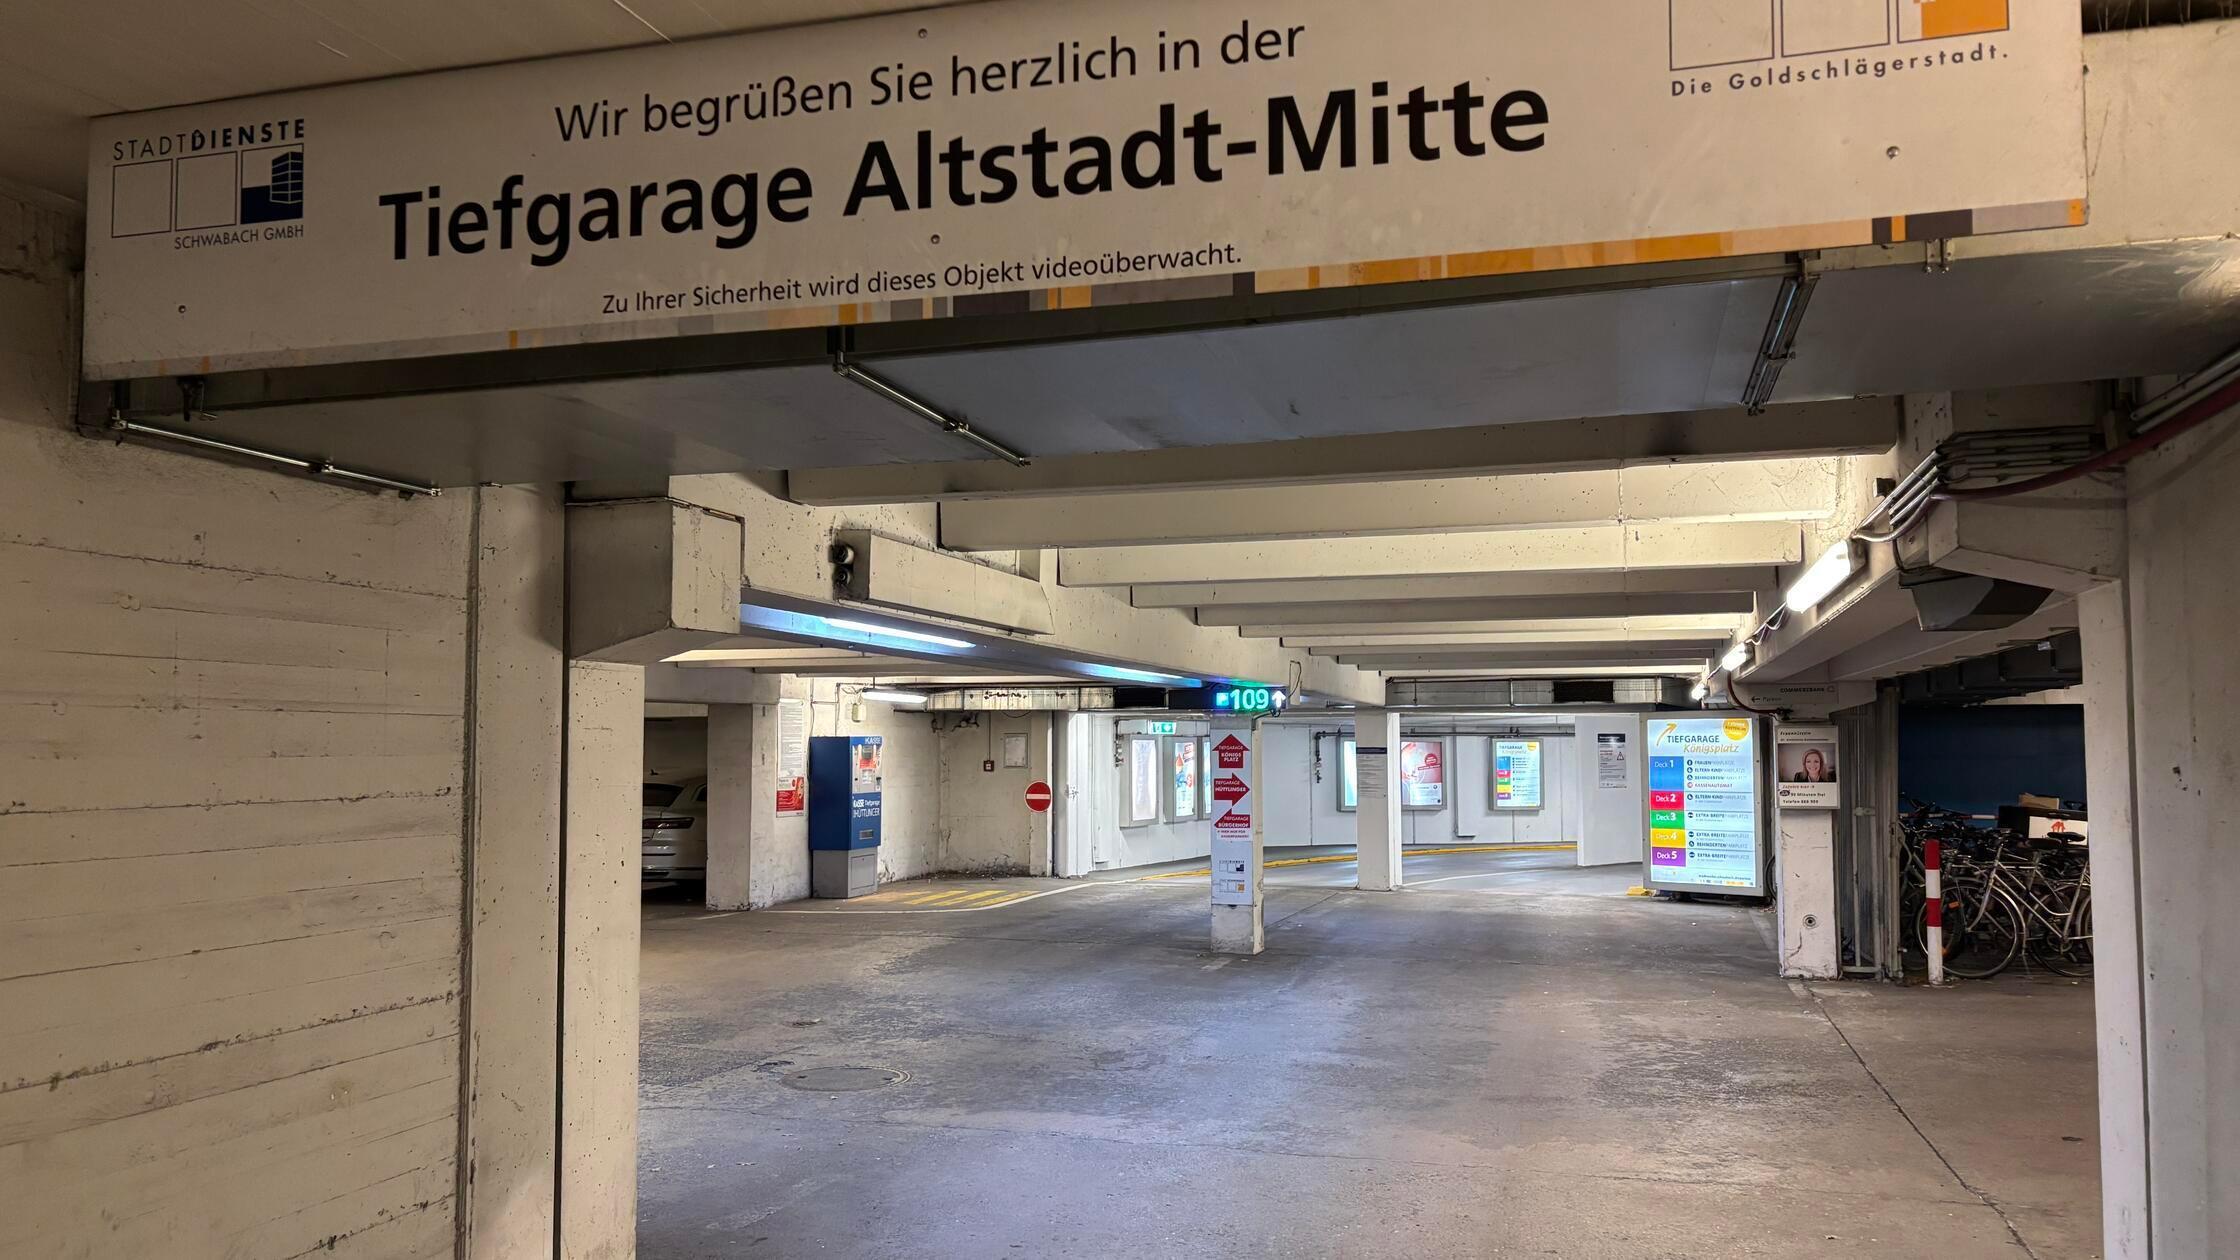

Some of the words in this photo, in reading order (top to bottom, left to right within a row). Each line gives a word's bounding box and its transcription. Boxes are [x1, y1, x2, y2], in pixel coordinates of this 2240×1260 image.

[1671, 77, 1713, 97] Die
[1728, 43, 2009, 91] Goldschlägerstadt.
[555, 100, 629, 141] Wir
[645, 76, 852, 136] begrüßen
[871, 63, 934, 106] Sie
[952, 36, 1137, 97] herzlich
[1159, 31, 1200, 73] in
[1220, 19, 1306, 66] der
[113, 117, 305, 161] STADTDIENSTE
[379, 167, 812, 267] Tiefgarage
[843, 81, 1550, 217] Altstadt-Mitte
[173, 233, 259, 250] SCHWABACH
[263, 226, 305, 242] GMBH
[602, 294, 628, 315] Zu
[636, 290, 687, 312] Ihrer
[693, 278, 803, 307] Sicherheit
[808, 272, 860, 298] wird
[867, 266, 937, 294] dieses
[944, 260, 1025, 290] Objekt
[1031, 243, 1242, 281] videoüberwacht.
[1230, 688, 1268, 710] 109
[1667, 735, 1720, 743] TIEFGARAGE
[1683, 743, 1740, 755] Königsplatz
[1669, 759, 1674, 768] 1
[1670, 793, 1676, 802] 2
[1655, 813, 1670, 821] Deck
[1670, 812, 1676, 821] 3
[1670, 832, 1677, 840] 4
[1656, 851, 1671, 859] Deck
[1671, 850, 1677, 859] 5
